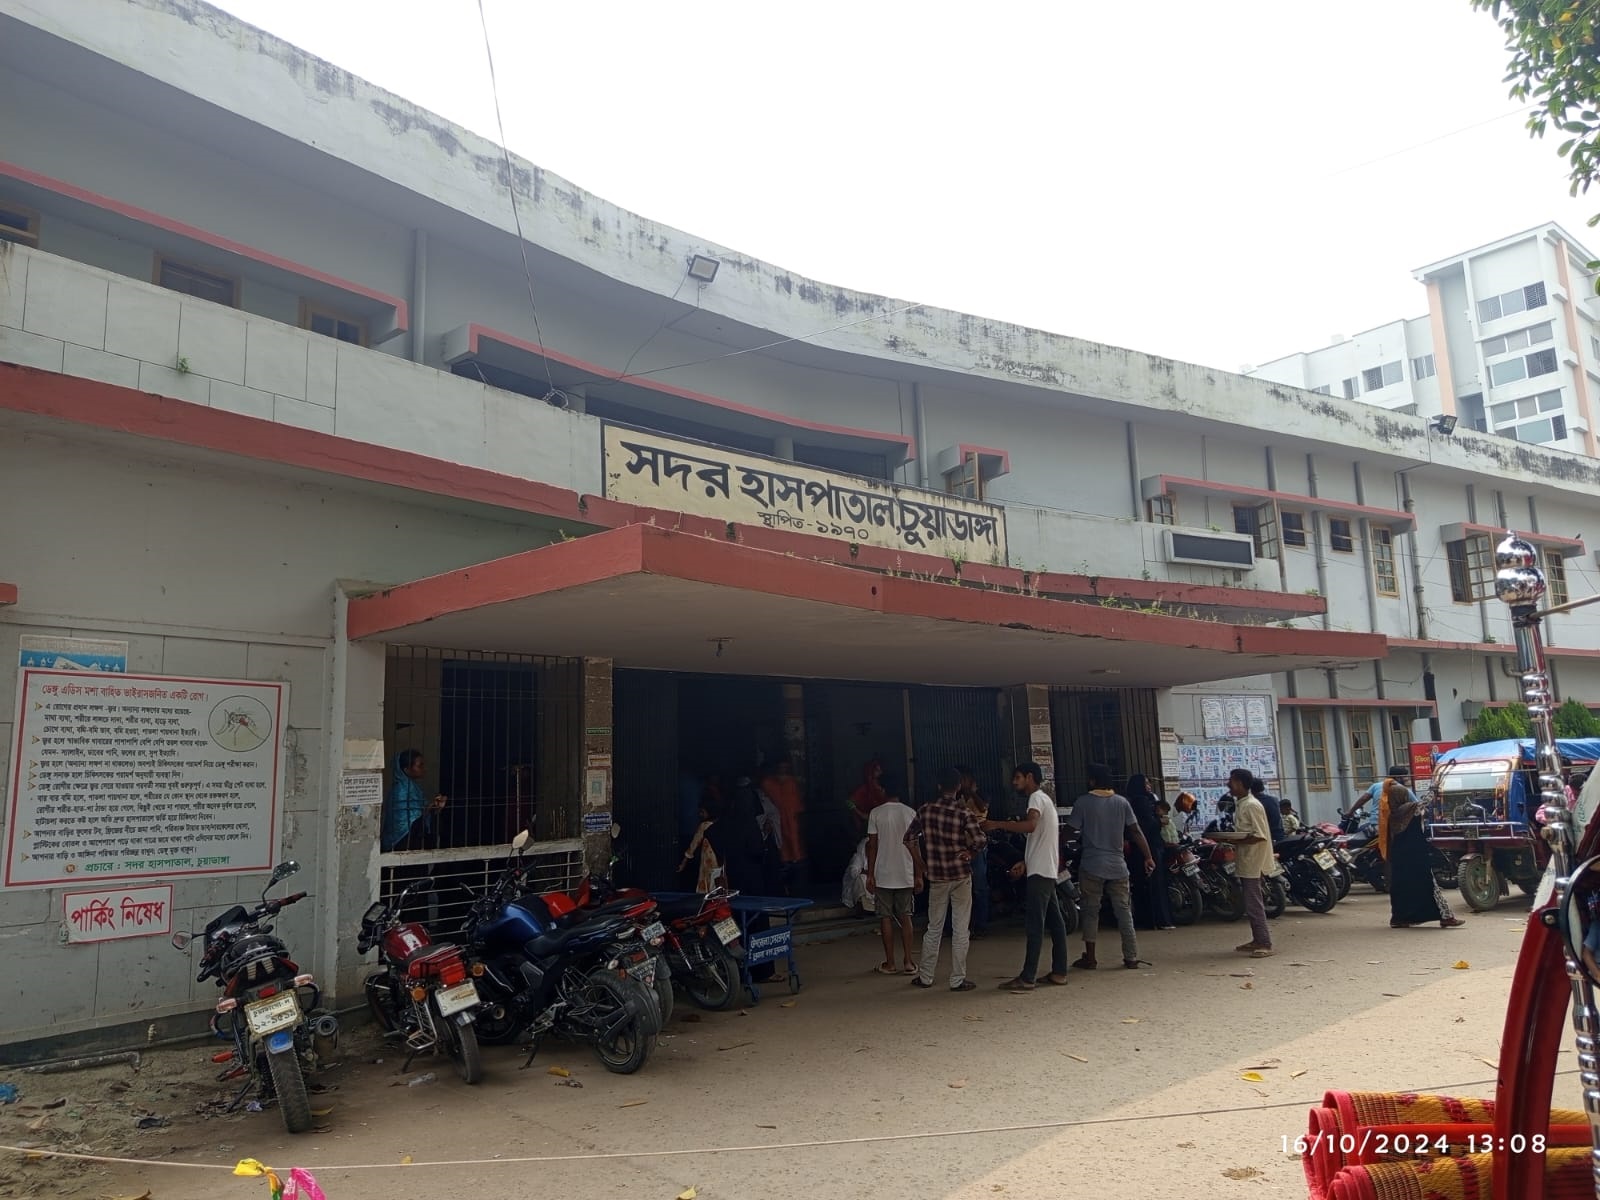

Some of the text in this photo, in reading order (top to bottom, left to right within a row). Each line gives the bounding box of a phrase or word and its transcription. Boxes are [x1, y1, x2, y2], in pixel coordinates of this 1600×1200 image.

[620, 441, 731, 499] সদর
[757, 509, 804, 528] স্থাপিত
[815, 520, 869, 540] ১৯৭০
[60, 682, 82, 696] এডিস
[84, 686, 98, 696] মশা
[99, 684, 121, 698] বাহিত
[123, 686, 168, 700] ভাইরাসজনিত
[169, 688, 188, 700] একটি
[84, 861, 113, 872] প্রচারে
[123, 860, 145, 869] সদর
[146, 857, 194, 869] হাসপাতাল,
[197, 855, 230, 867] চুয়াডাঙ্গা
[71, 897, 165, 932] পার্কিং নিষেধ
